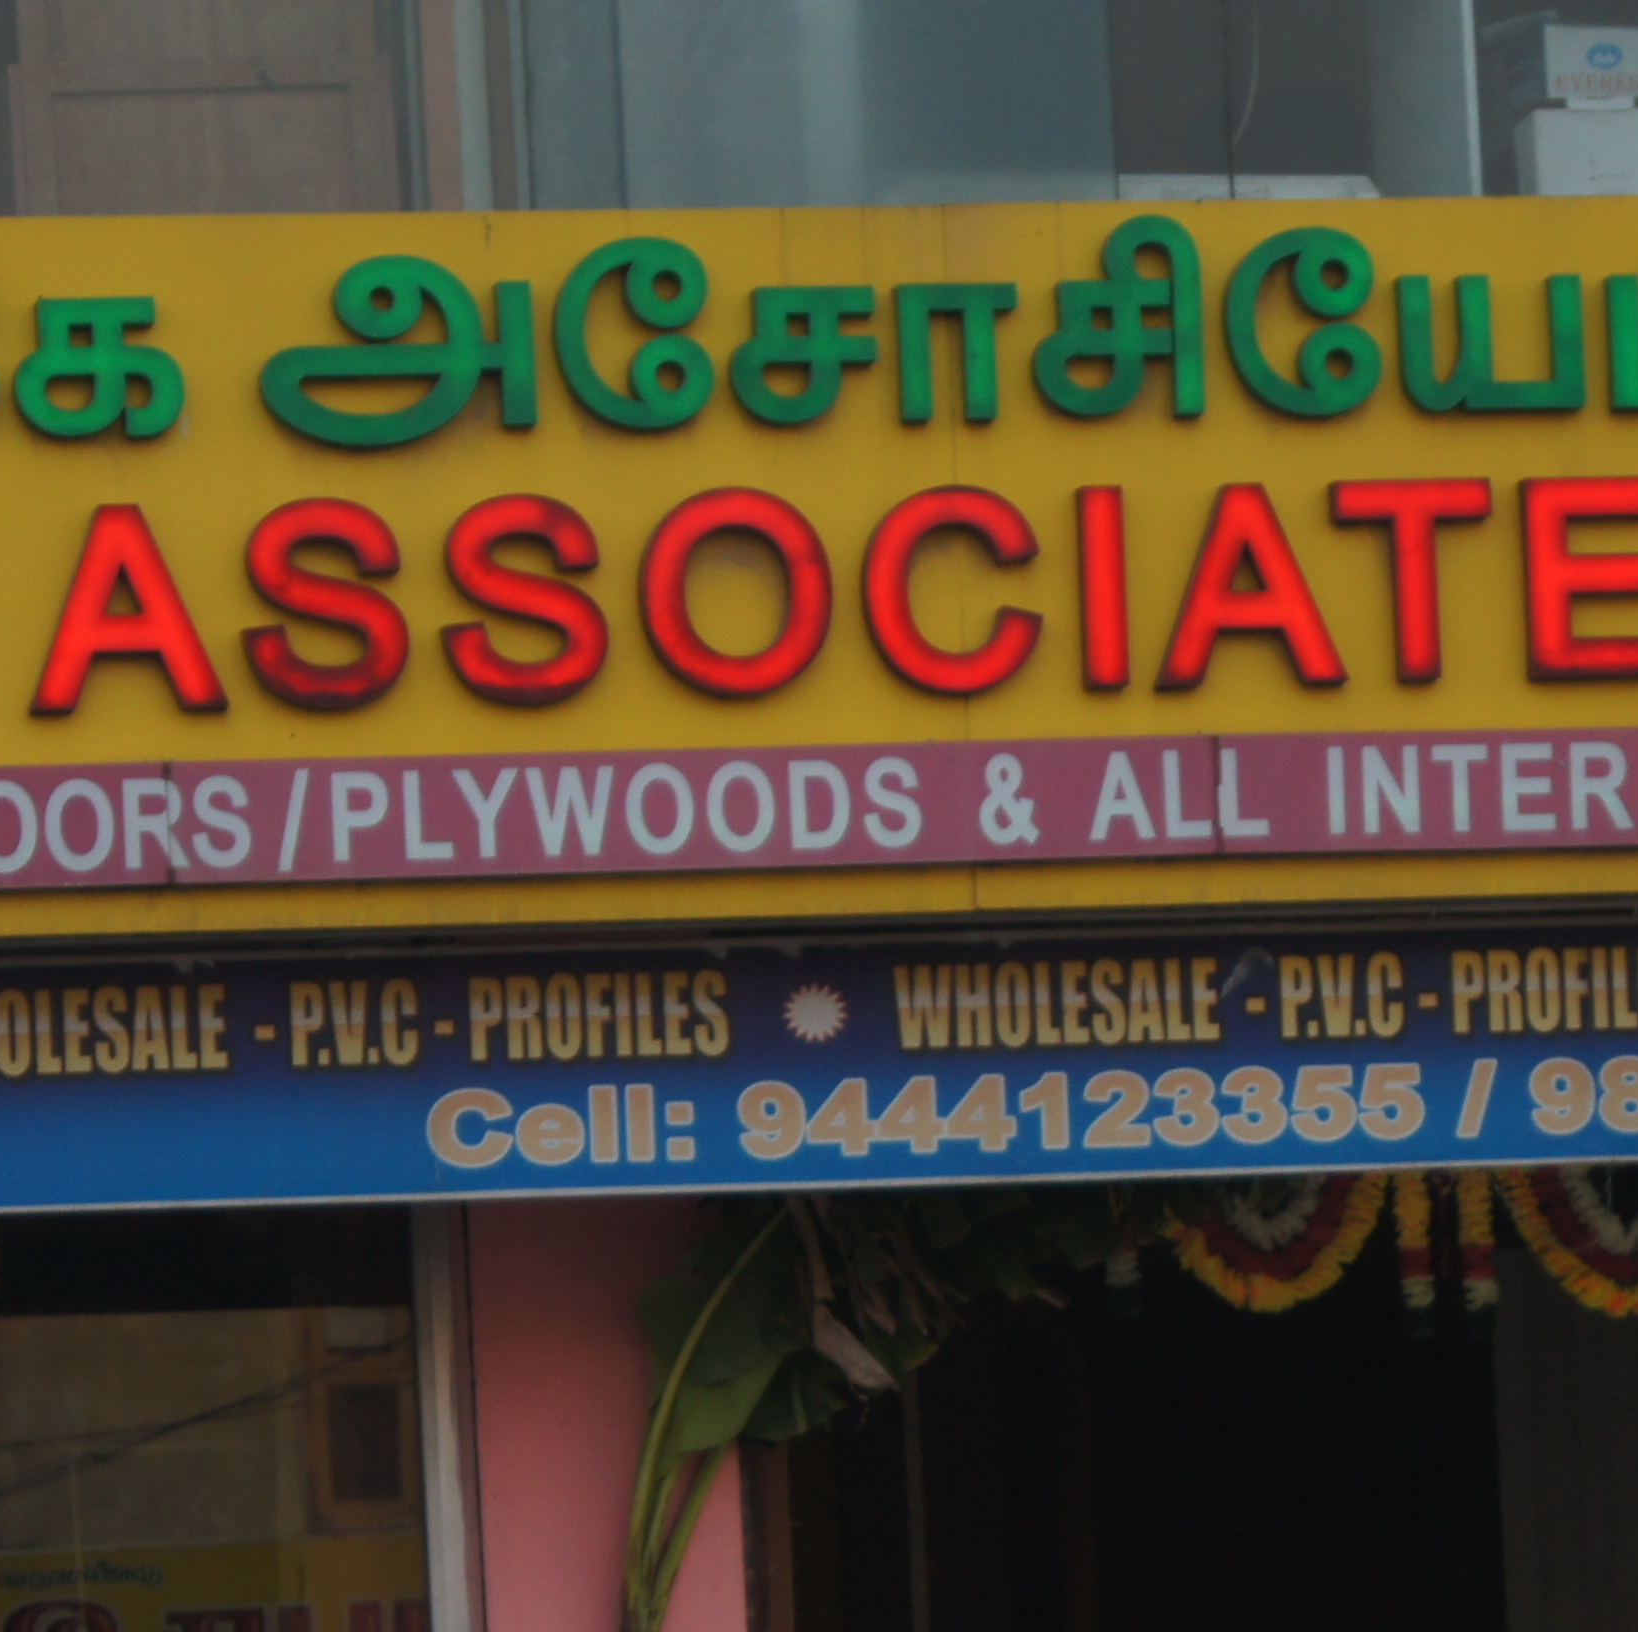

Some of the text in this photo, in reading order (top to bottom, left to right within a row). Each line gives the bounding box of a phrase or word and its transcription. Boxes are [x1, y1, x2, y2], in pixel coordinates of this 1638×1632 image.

[979, 752, 1041, 846] &
[1089, 746, 1270, 842] ALL
[289, 976, 422, 1068] P.V.C
[469, 970, 731, 1064] PROFILES
[892, 952, 1222, 1051] WHOLESALE
[1279, 951, 1405, 1039] P.V.C
[426, 1083, 697, 1171] Cell:
[737, 1057, 1427, 1161] 9444123355
